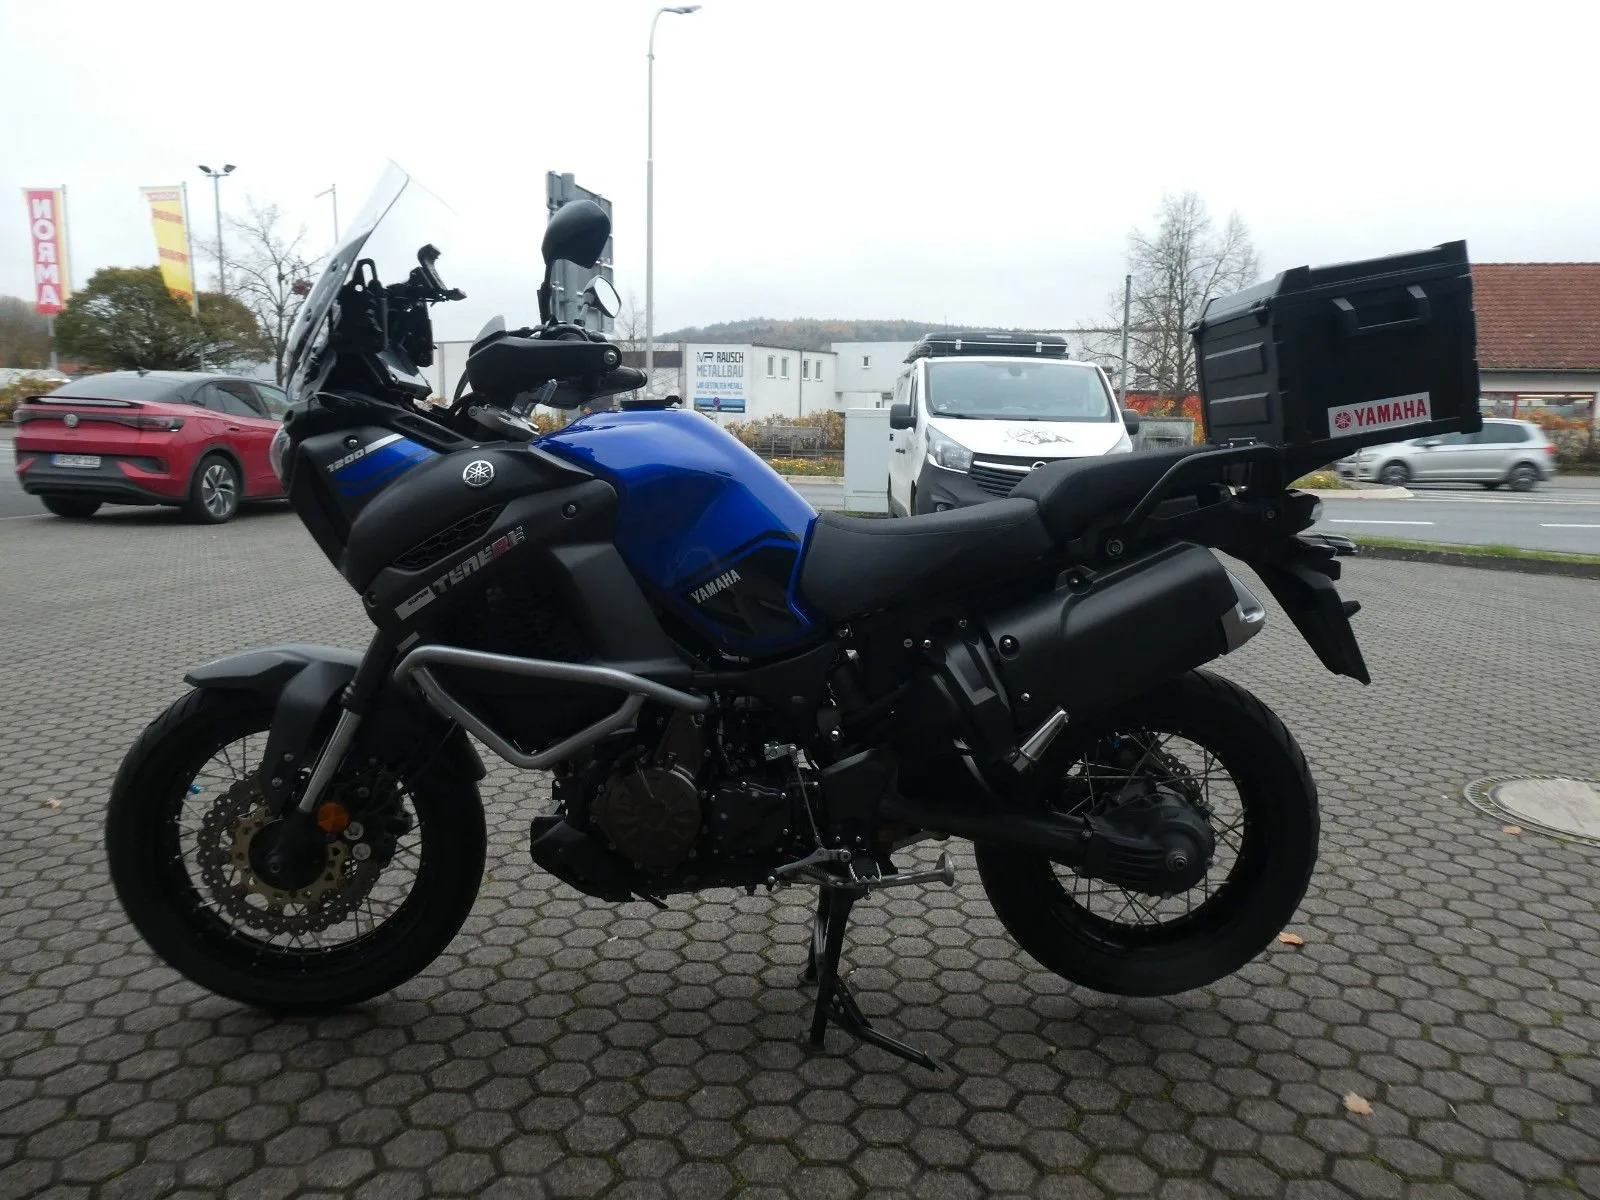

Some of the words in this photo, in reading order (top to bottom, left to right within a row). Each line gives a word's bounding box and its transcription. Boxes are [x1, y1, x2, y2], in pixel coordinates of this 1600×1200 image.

[716, 351, 744, 363] RAUSCH
[696, 364, 744, 378] METALLBAU
[1354, 398, 1427, 427] YAMAHA
[326, 448, 365, 473] 1200
[690, 569, 741, 604] YAMAHA
